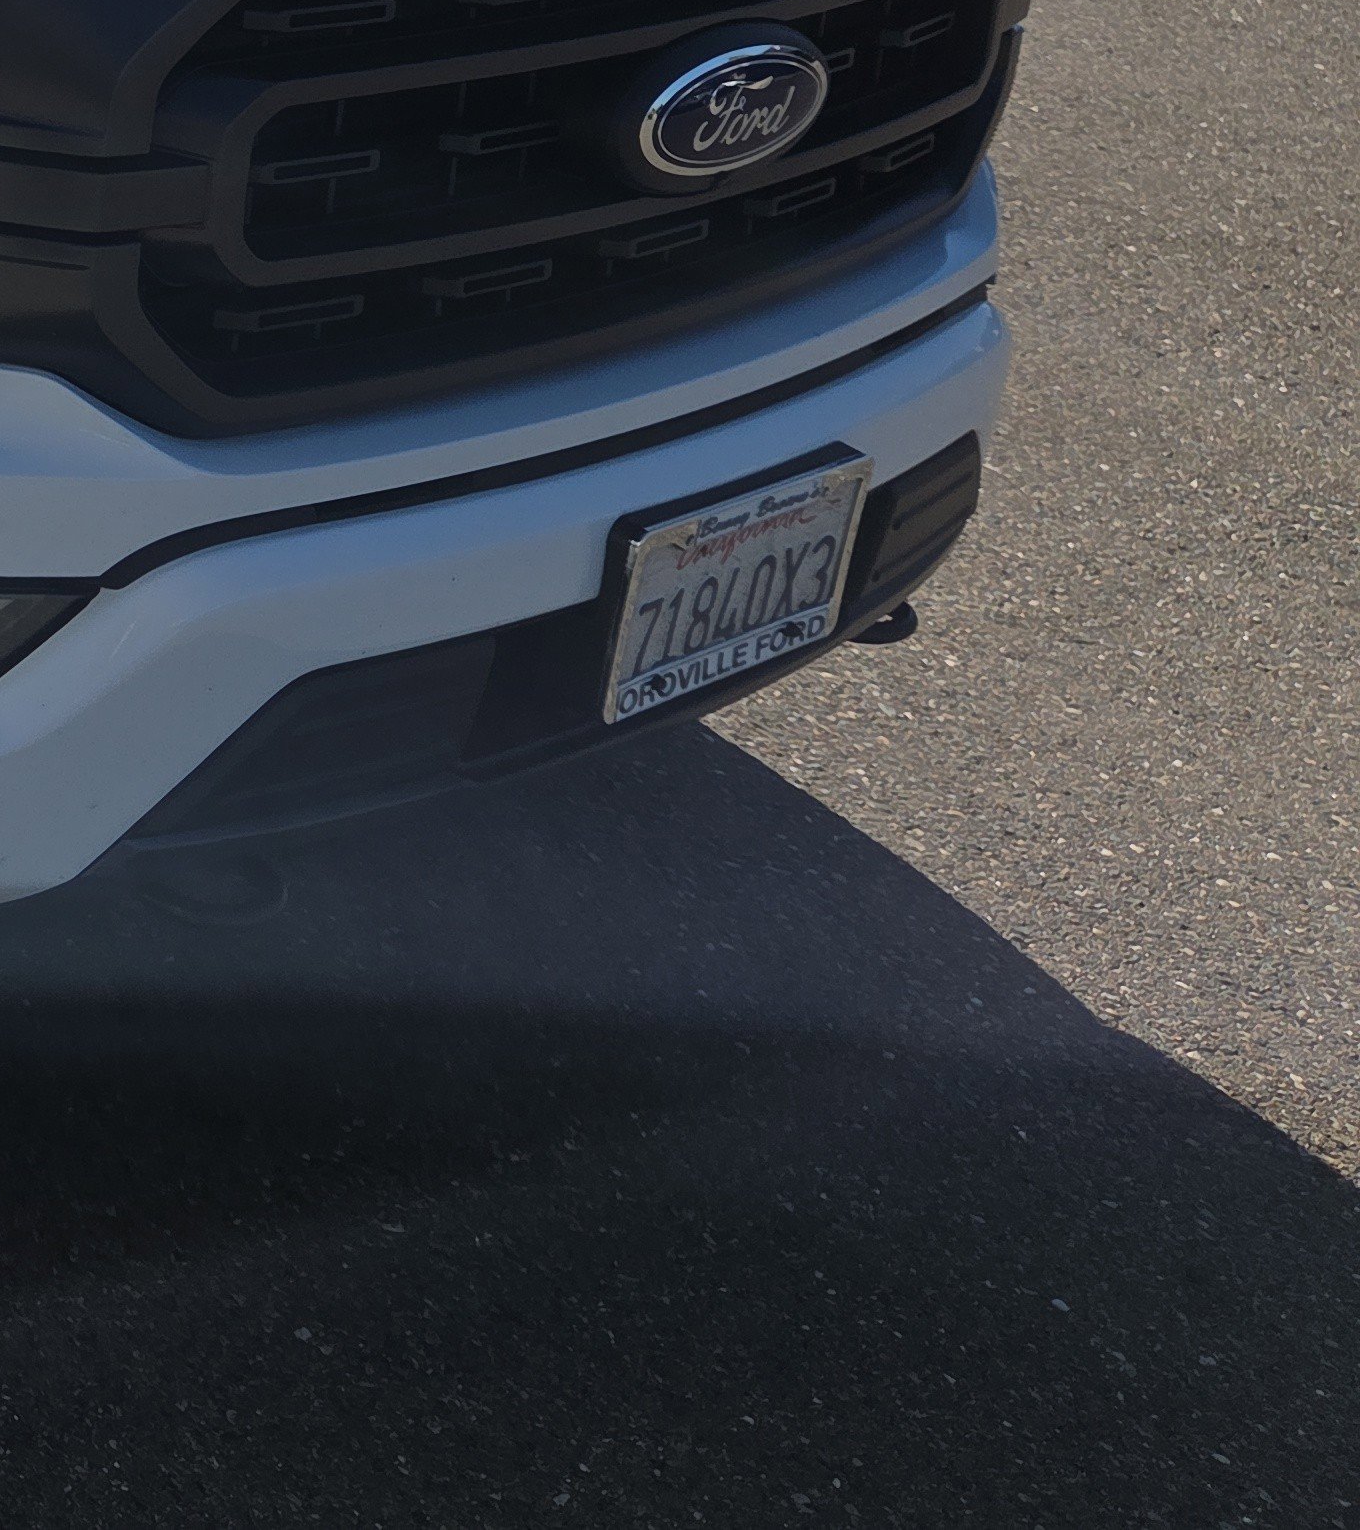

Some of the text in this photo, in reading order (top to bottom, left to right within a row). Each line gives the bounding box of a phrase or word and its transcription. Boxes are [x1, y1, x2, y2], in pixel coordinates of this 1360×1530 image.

[692, 76, 795, 152] Ford
[633, 534, 837, 676] 71840X3
[618, 614, 826, 715] OROVILLE FORD
